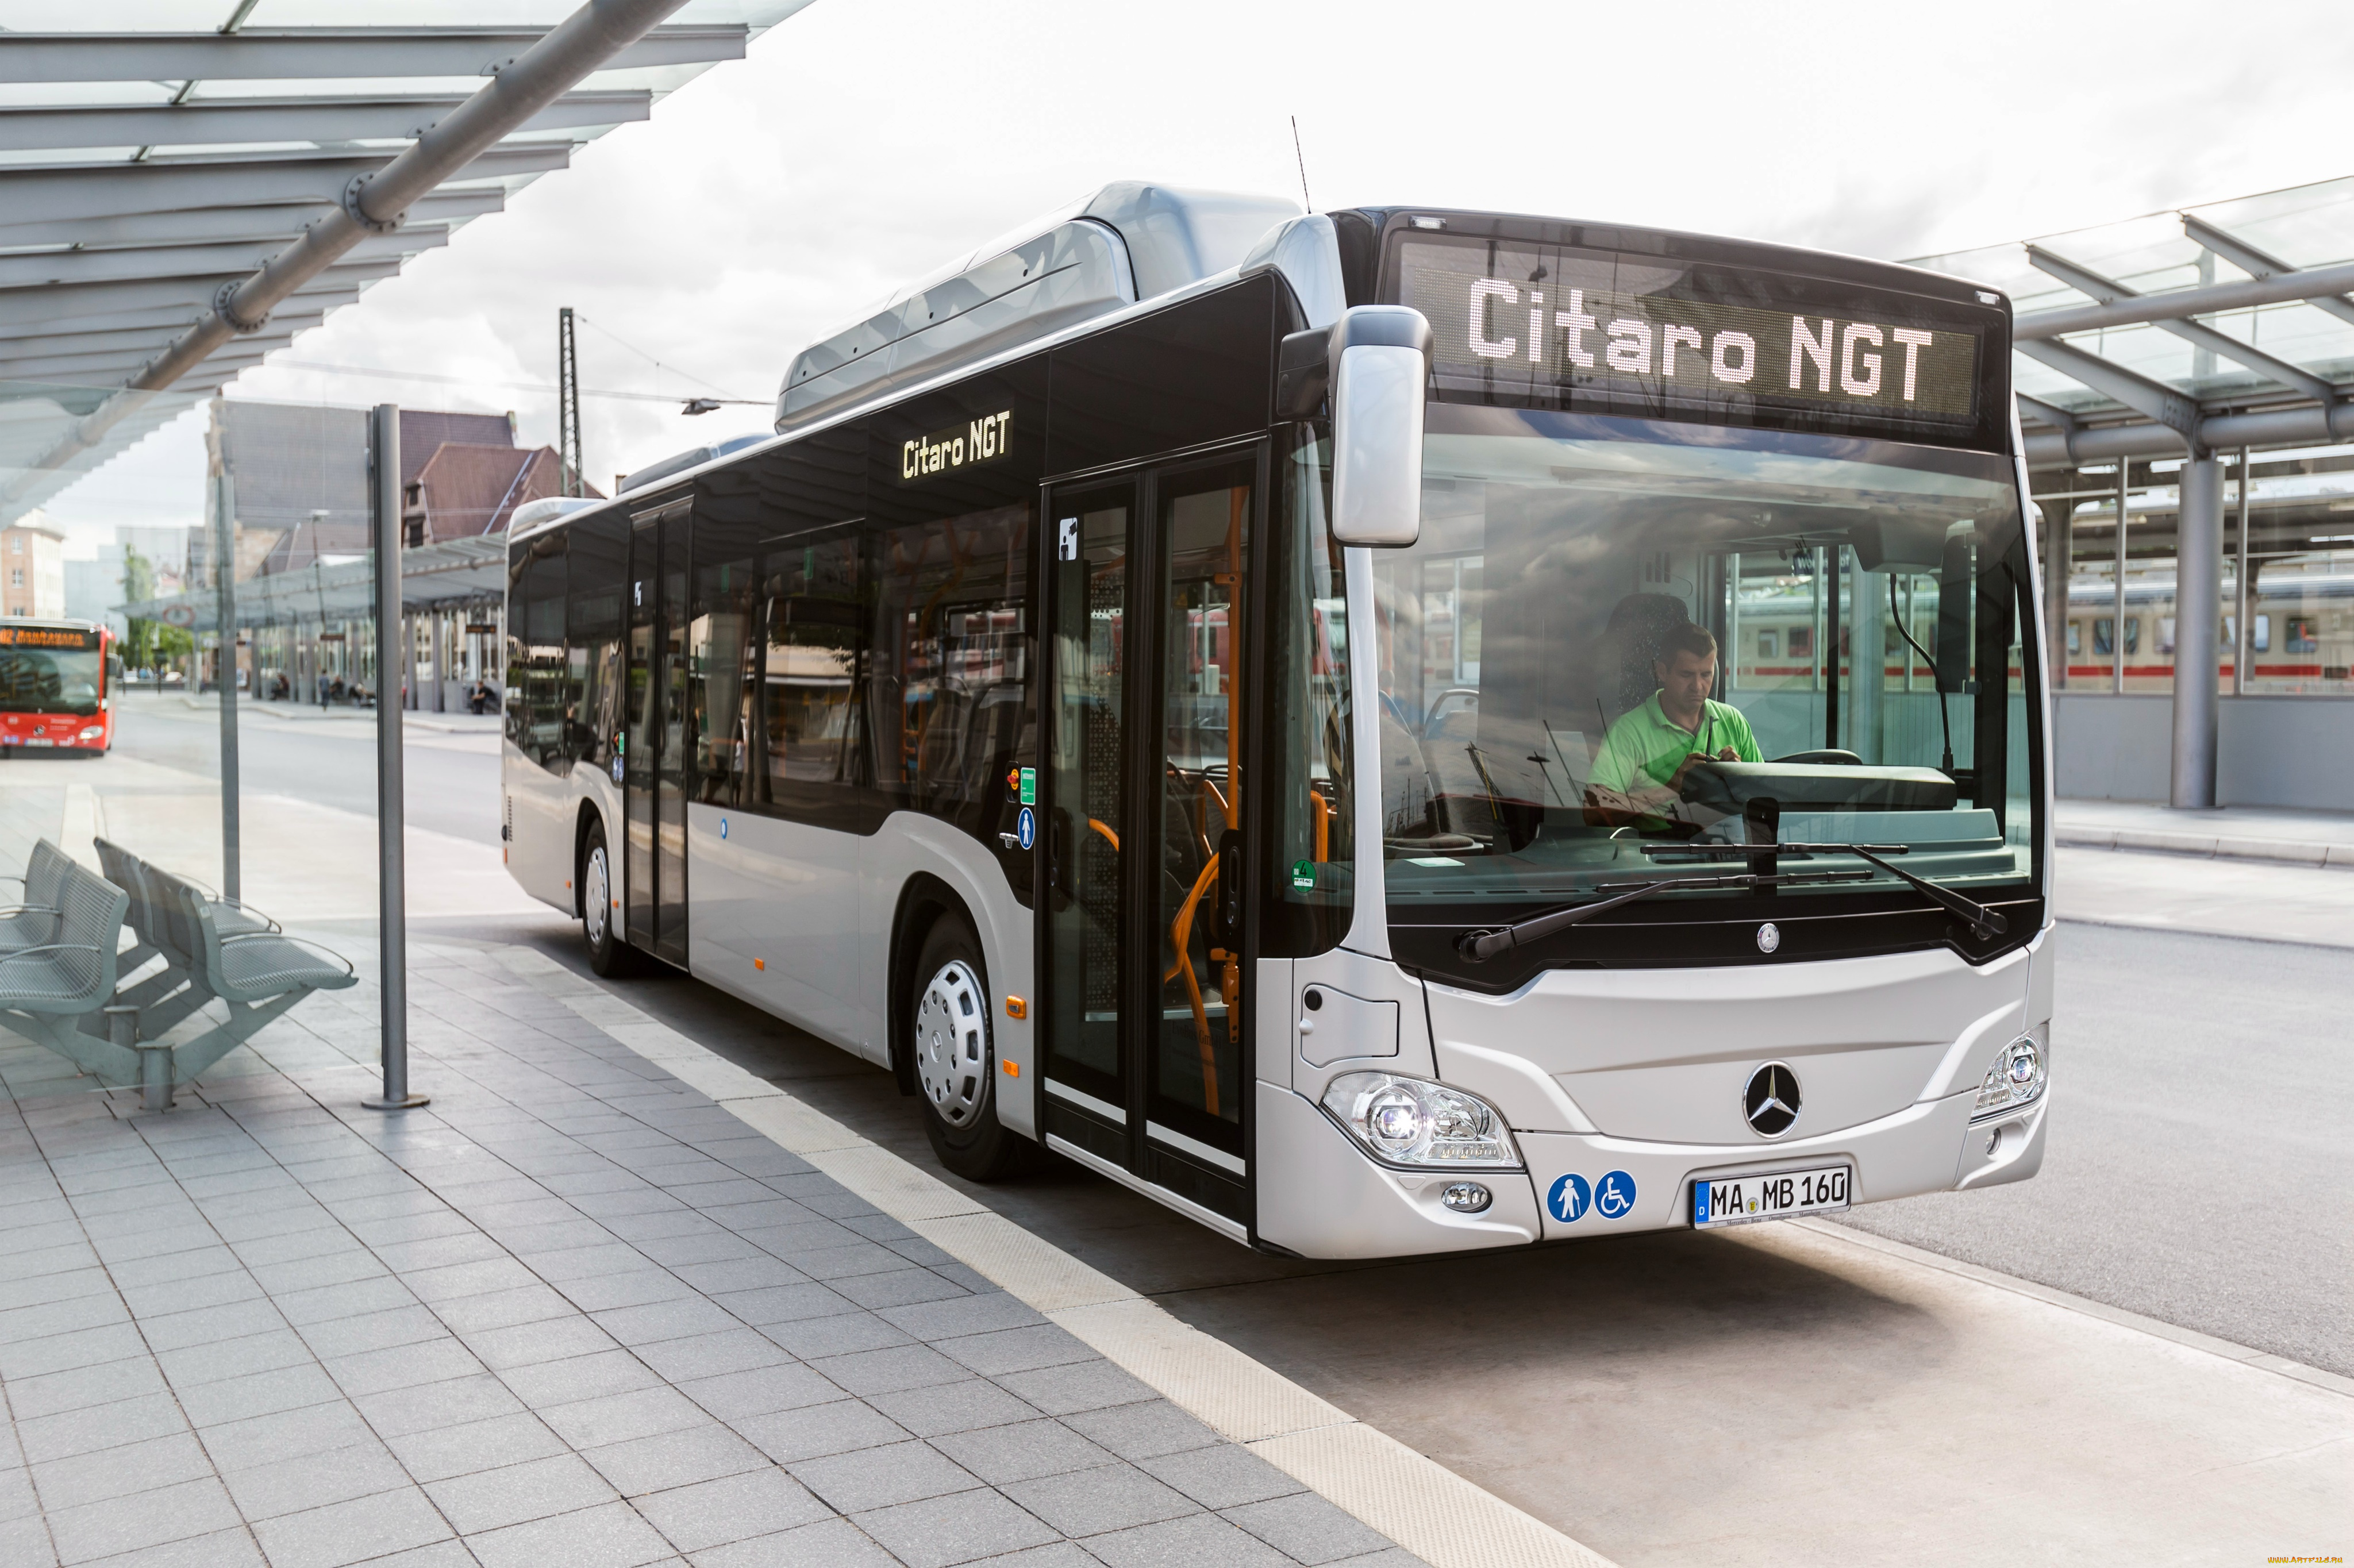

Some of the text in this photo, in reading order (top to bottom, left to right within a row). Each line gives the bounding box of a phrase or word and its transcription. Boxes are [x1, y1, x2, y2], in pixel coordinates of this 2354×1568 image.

[1469, 278, 1932, 401] Citaro NGT
[903, 411, 1010, 479] Citaro NGT
[1300, 862, 1307, 877] 4
[1172, 1021, 1221, 1049] EvoBus GmbH
[1699, 1172, 1845, 1216] D MA MB 160
